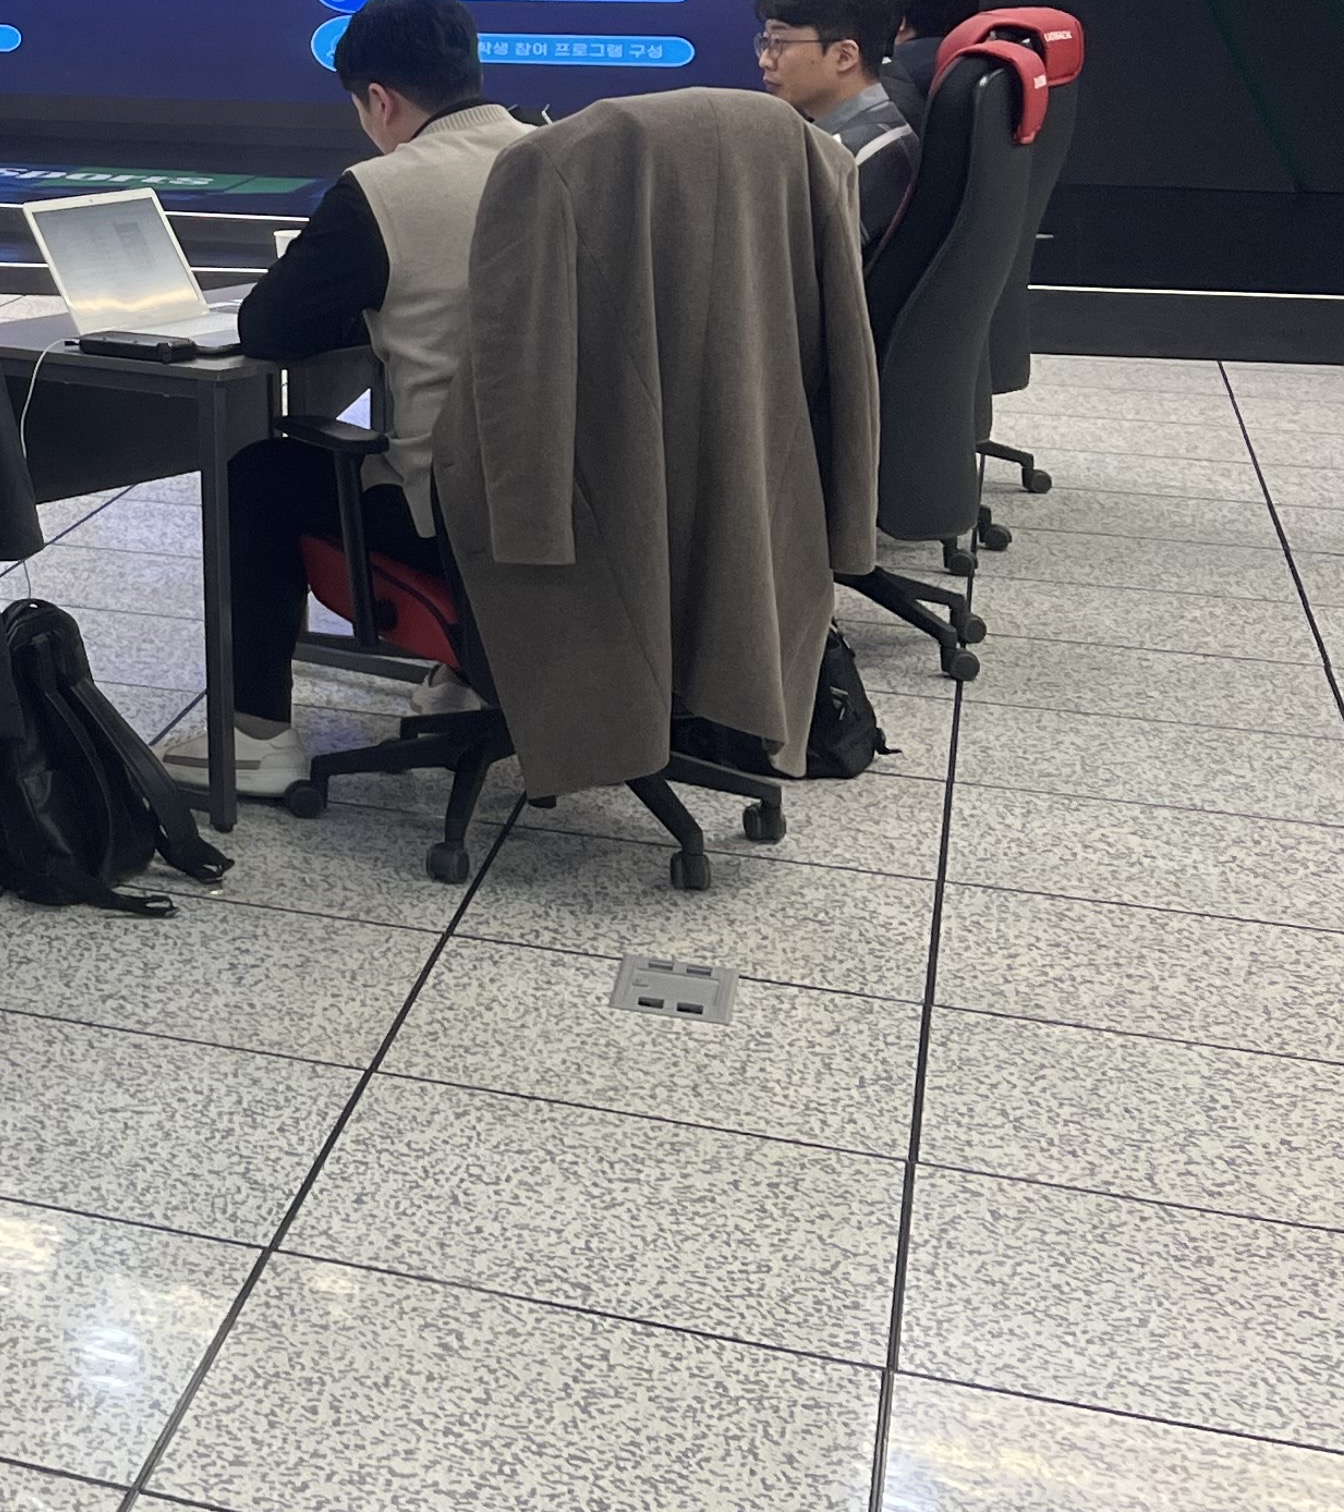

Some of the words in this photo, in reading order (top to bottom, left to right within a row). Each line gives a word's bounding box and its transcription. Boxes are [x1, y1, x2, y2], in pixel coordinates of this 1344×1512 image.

[515, 42, 548, 57] 참여
[555, 43, 623, 58] 프로그램
[629, 44, 663, 59] 구성
